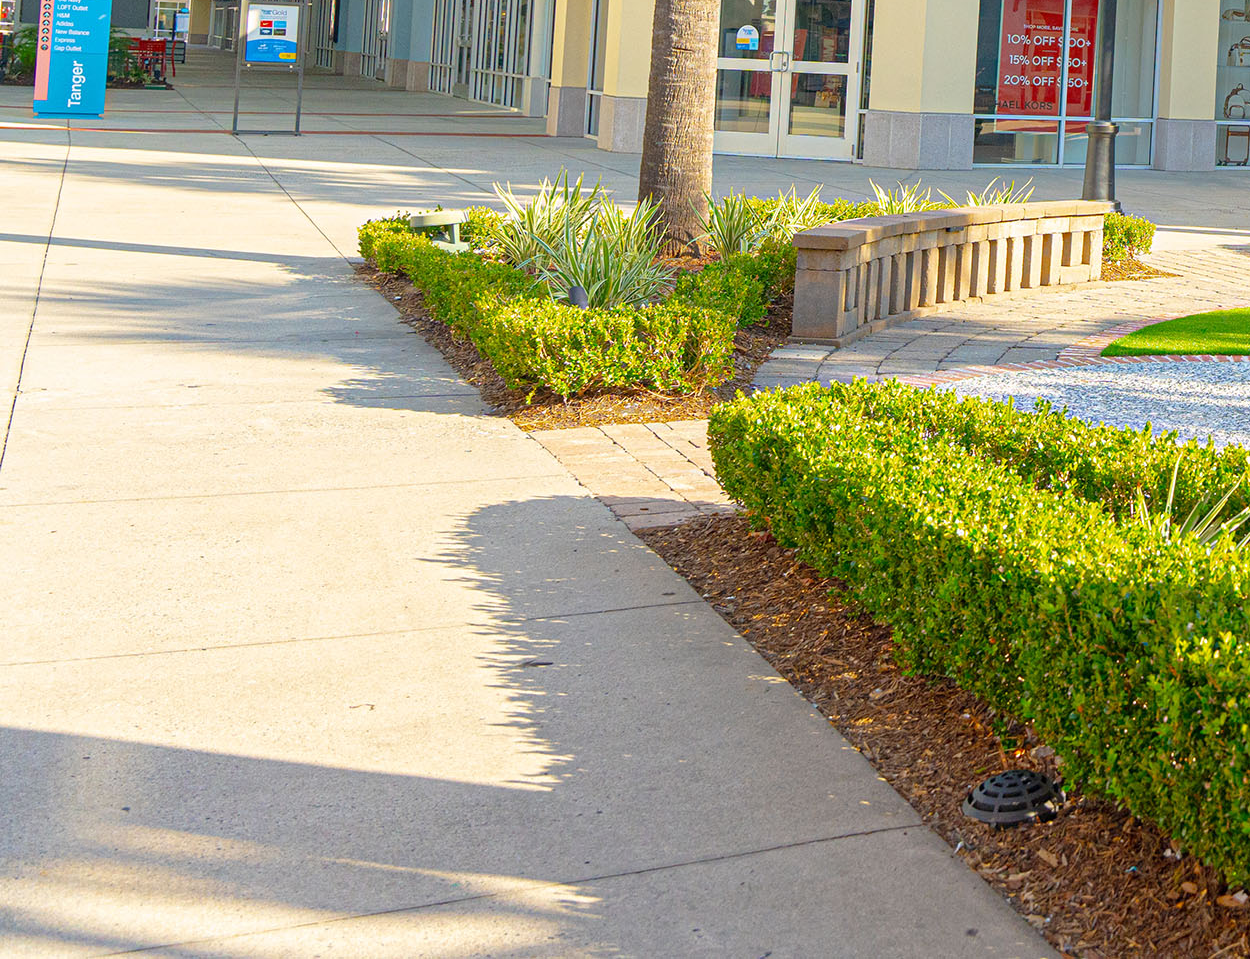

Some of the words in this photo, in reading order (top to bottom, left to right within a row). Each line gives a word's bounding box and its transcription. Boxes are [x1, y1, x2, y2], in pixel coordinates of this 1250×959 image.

[1007, 34, 1032, 45] 10%
[1033, 36, 1056, 47] OFF
[1057, 37, 1092, 48] $00+
[1009, 54, 1030, 65] 15%
[1032, 56, 1055, 67] OFF
[1056, 57, 1088, 68] $50+
[67, 60, 86, 108] Tanger
[1004, 74, 1031, 85] 20%
[1032, 76, 1055, 87] OFF
[1056, 77, 1089, 88] $50+
[1024, 101, 1054, 111] KORS
